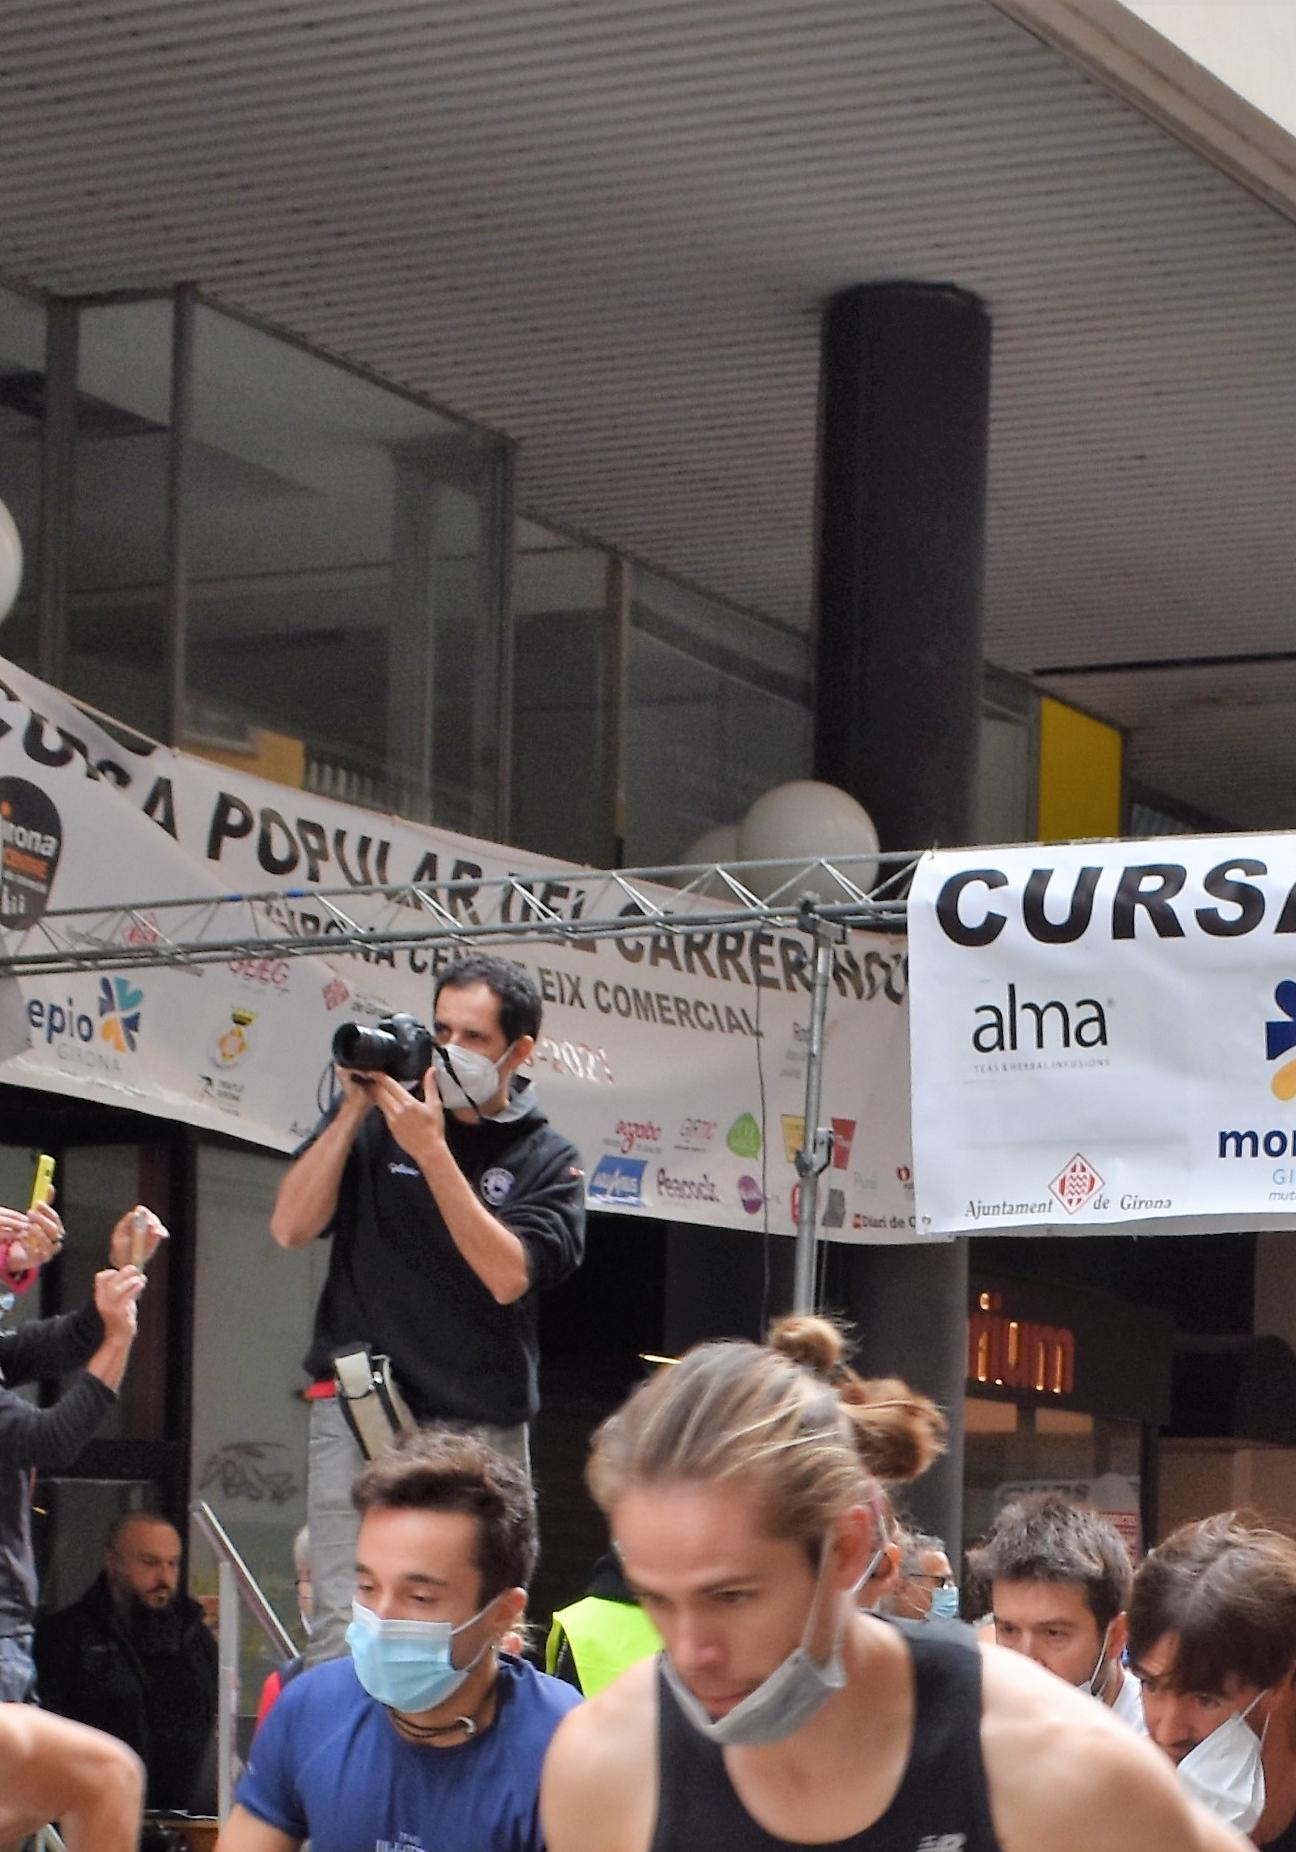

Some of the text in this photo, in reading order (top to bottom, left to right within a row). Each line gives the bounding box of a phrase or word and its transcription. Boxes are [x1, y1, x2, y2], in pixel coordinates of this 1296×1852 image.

[207, 791, 484, 928] POPULAR
[613, 902, 817, 994] CARRER
[538, 967, 586, 1009] EIX
[594, 980, 763, 1039] COMERCIAL
[972, 983, 1108, 1053] alma
[965, 1194, 1172, 1220] Ajuntament de Girona
